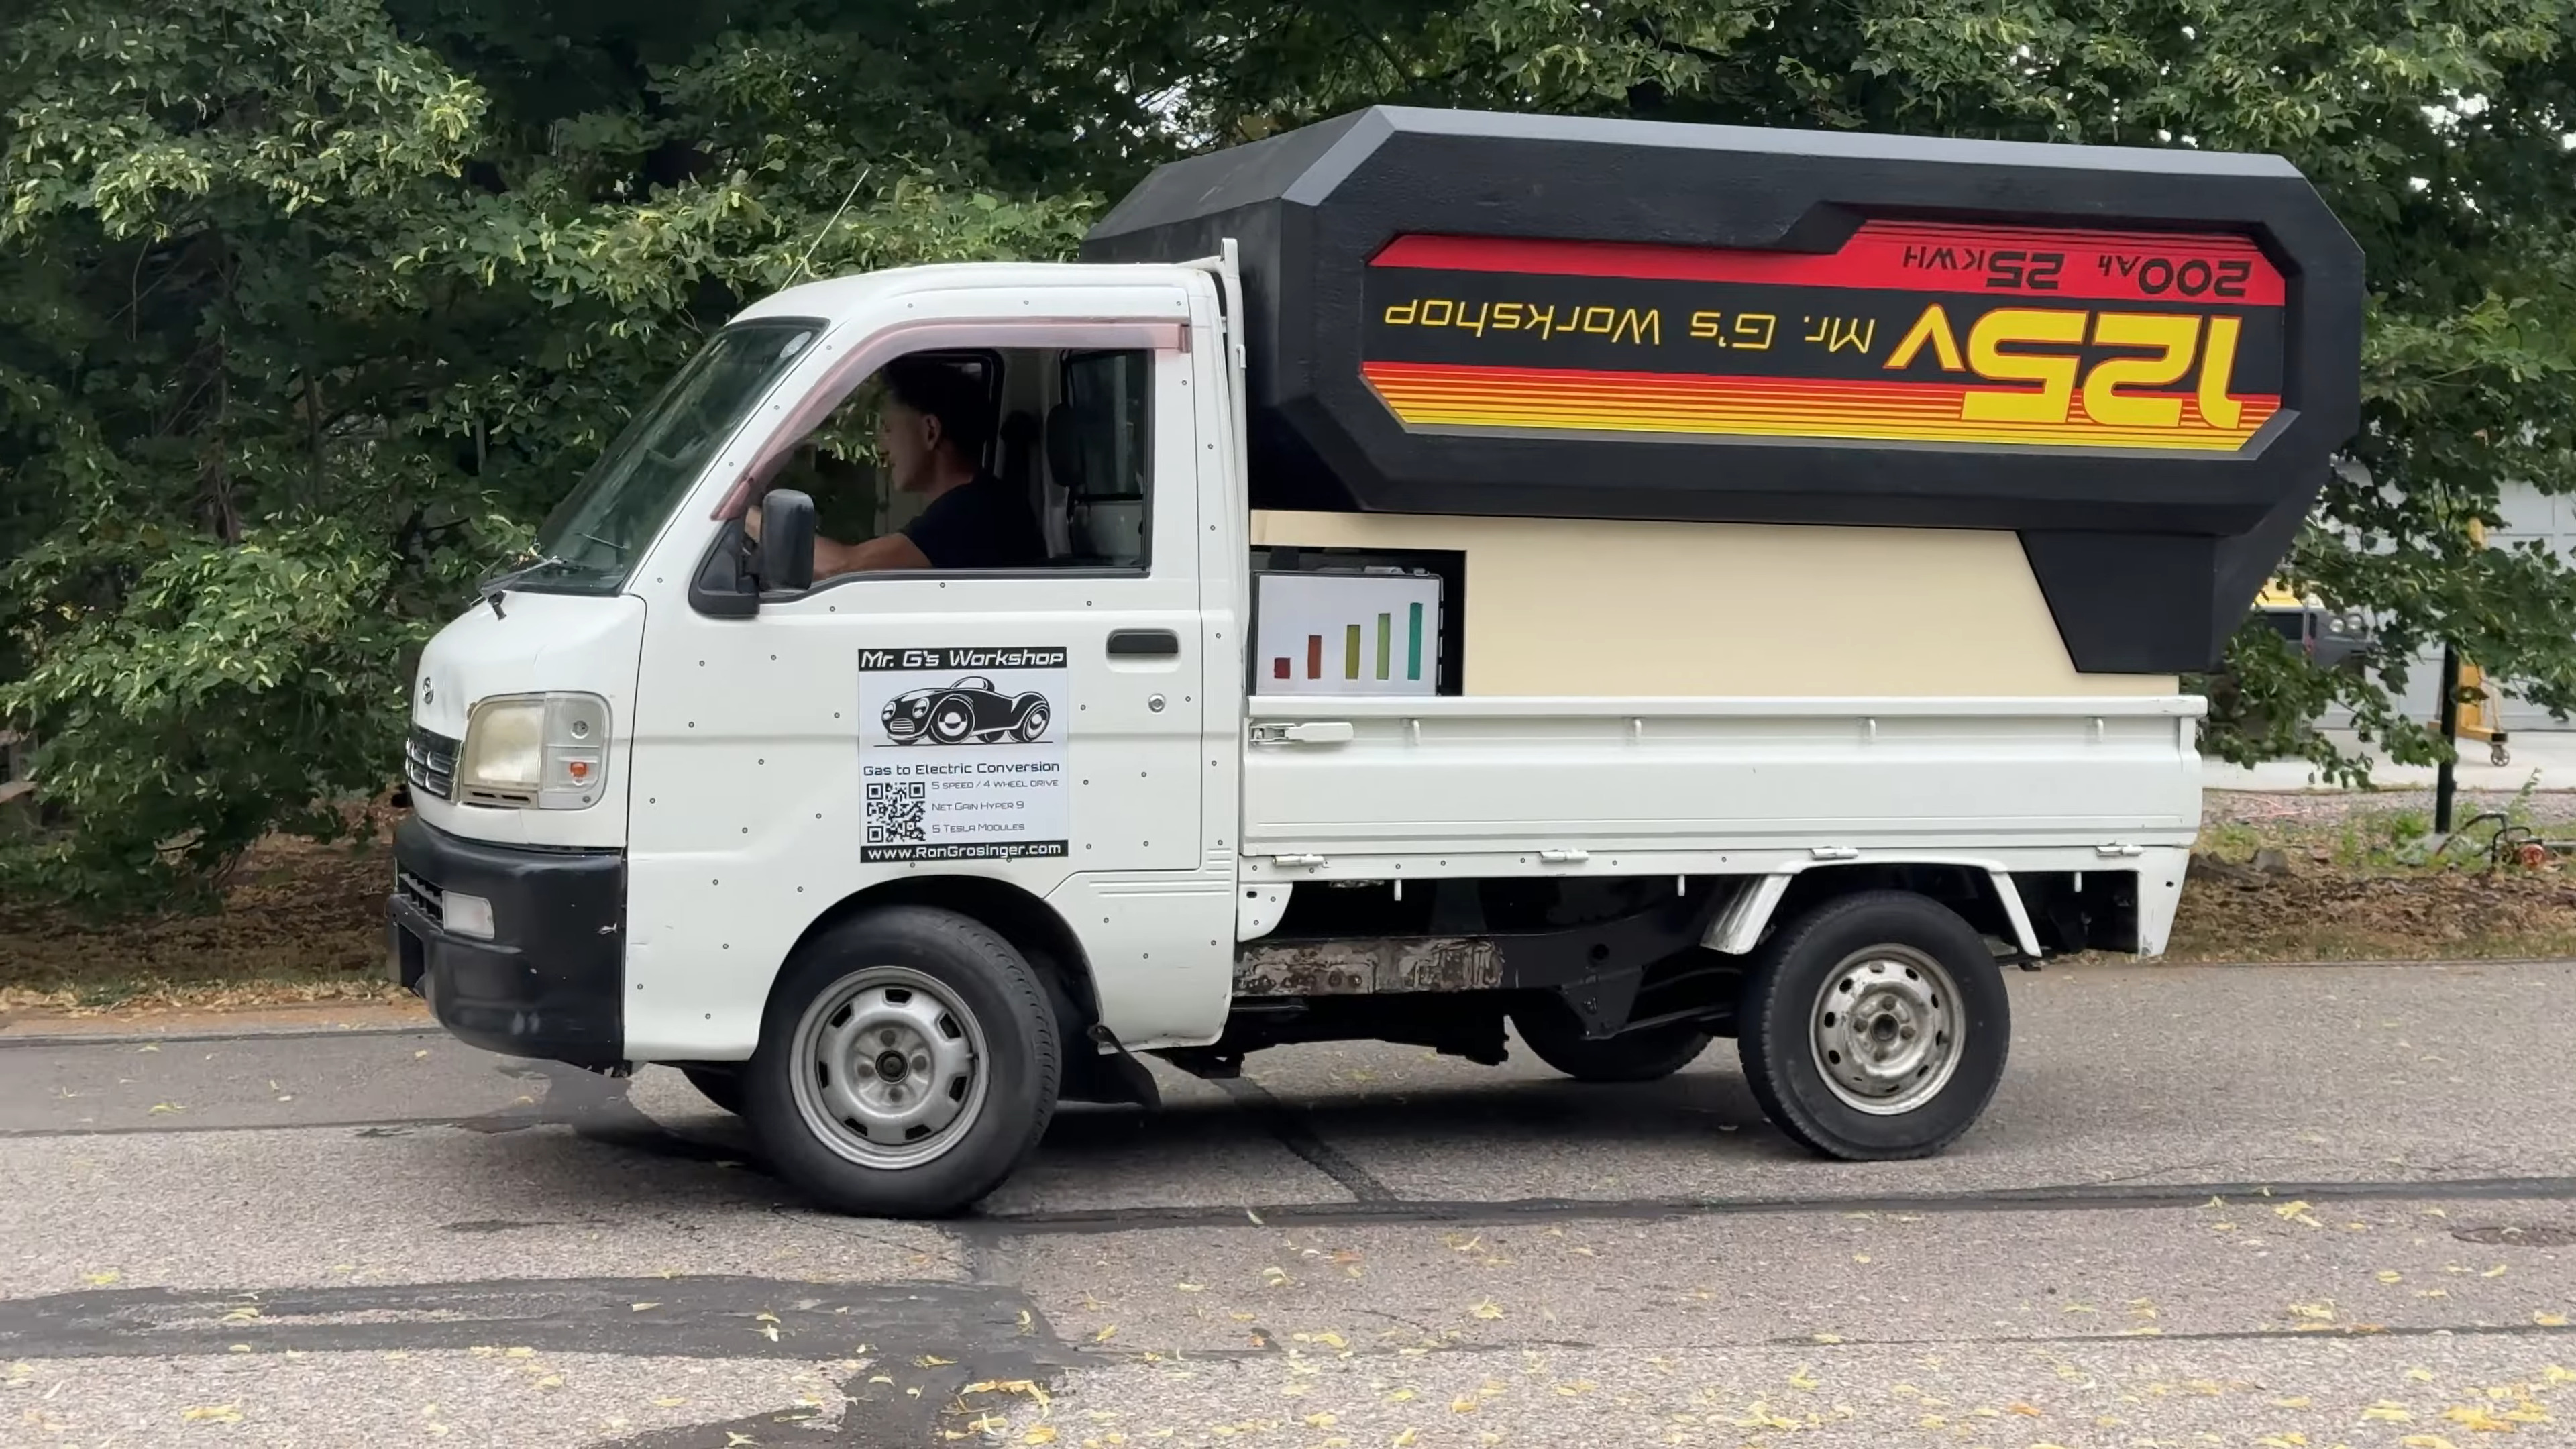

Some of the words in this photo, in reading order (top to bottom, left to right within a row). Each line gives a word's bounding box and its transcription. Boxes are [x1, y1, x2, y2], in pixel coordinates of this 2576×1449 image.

[1385, 299, 1660, 345] Workshop
[1690, 311, 1776, 349] G's
[1804, 316, 1875, 354] Mr.
[861, 650, 894, 667] Mr.
[902, 650, 939, 667] G's
[949, 649, 1064, 666] Workshop
[863, 766, 892, 776] Gas
[897, 765, 911, 775] to
[916, 763, 971, 775] Electric
[977, 761, 1059, 773] Conversion
[932, 781, 940, 789] 5
[942, 781, 974, 789] SPEED
[975, 780, 981, 788] /
[1016, 800, 1024, 809] 9
[932, 824, 941, 833] 5
[867, 843, 1061, 860] www.RonGrosinger.com
